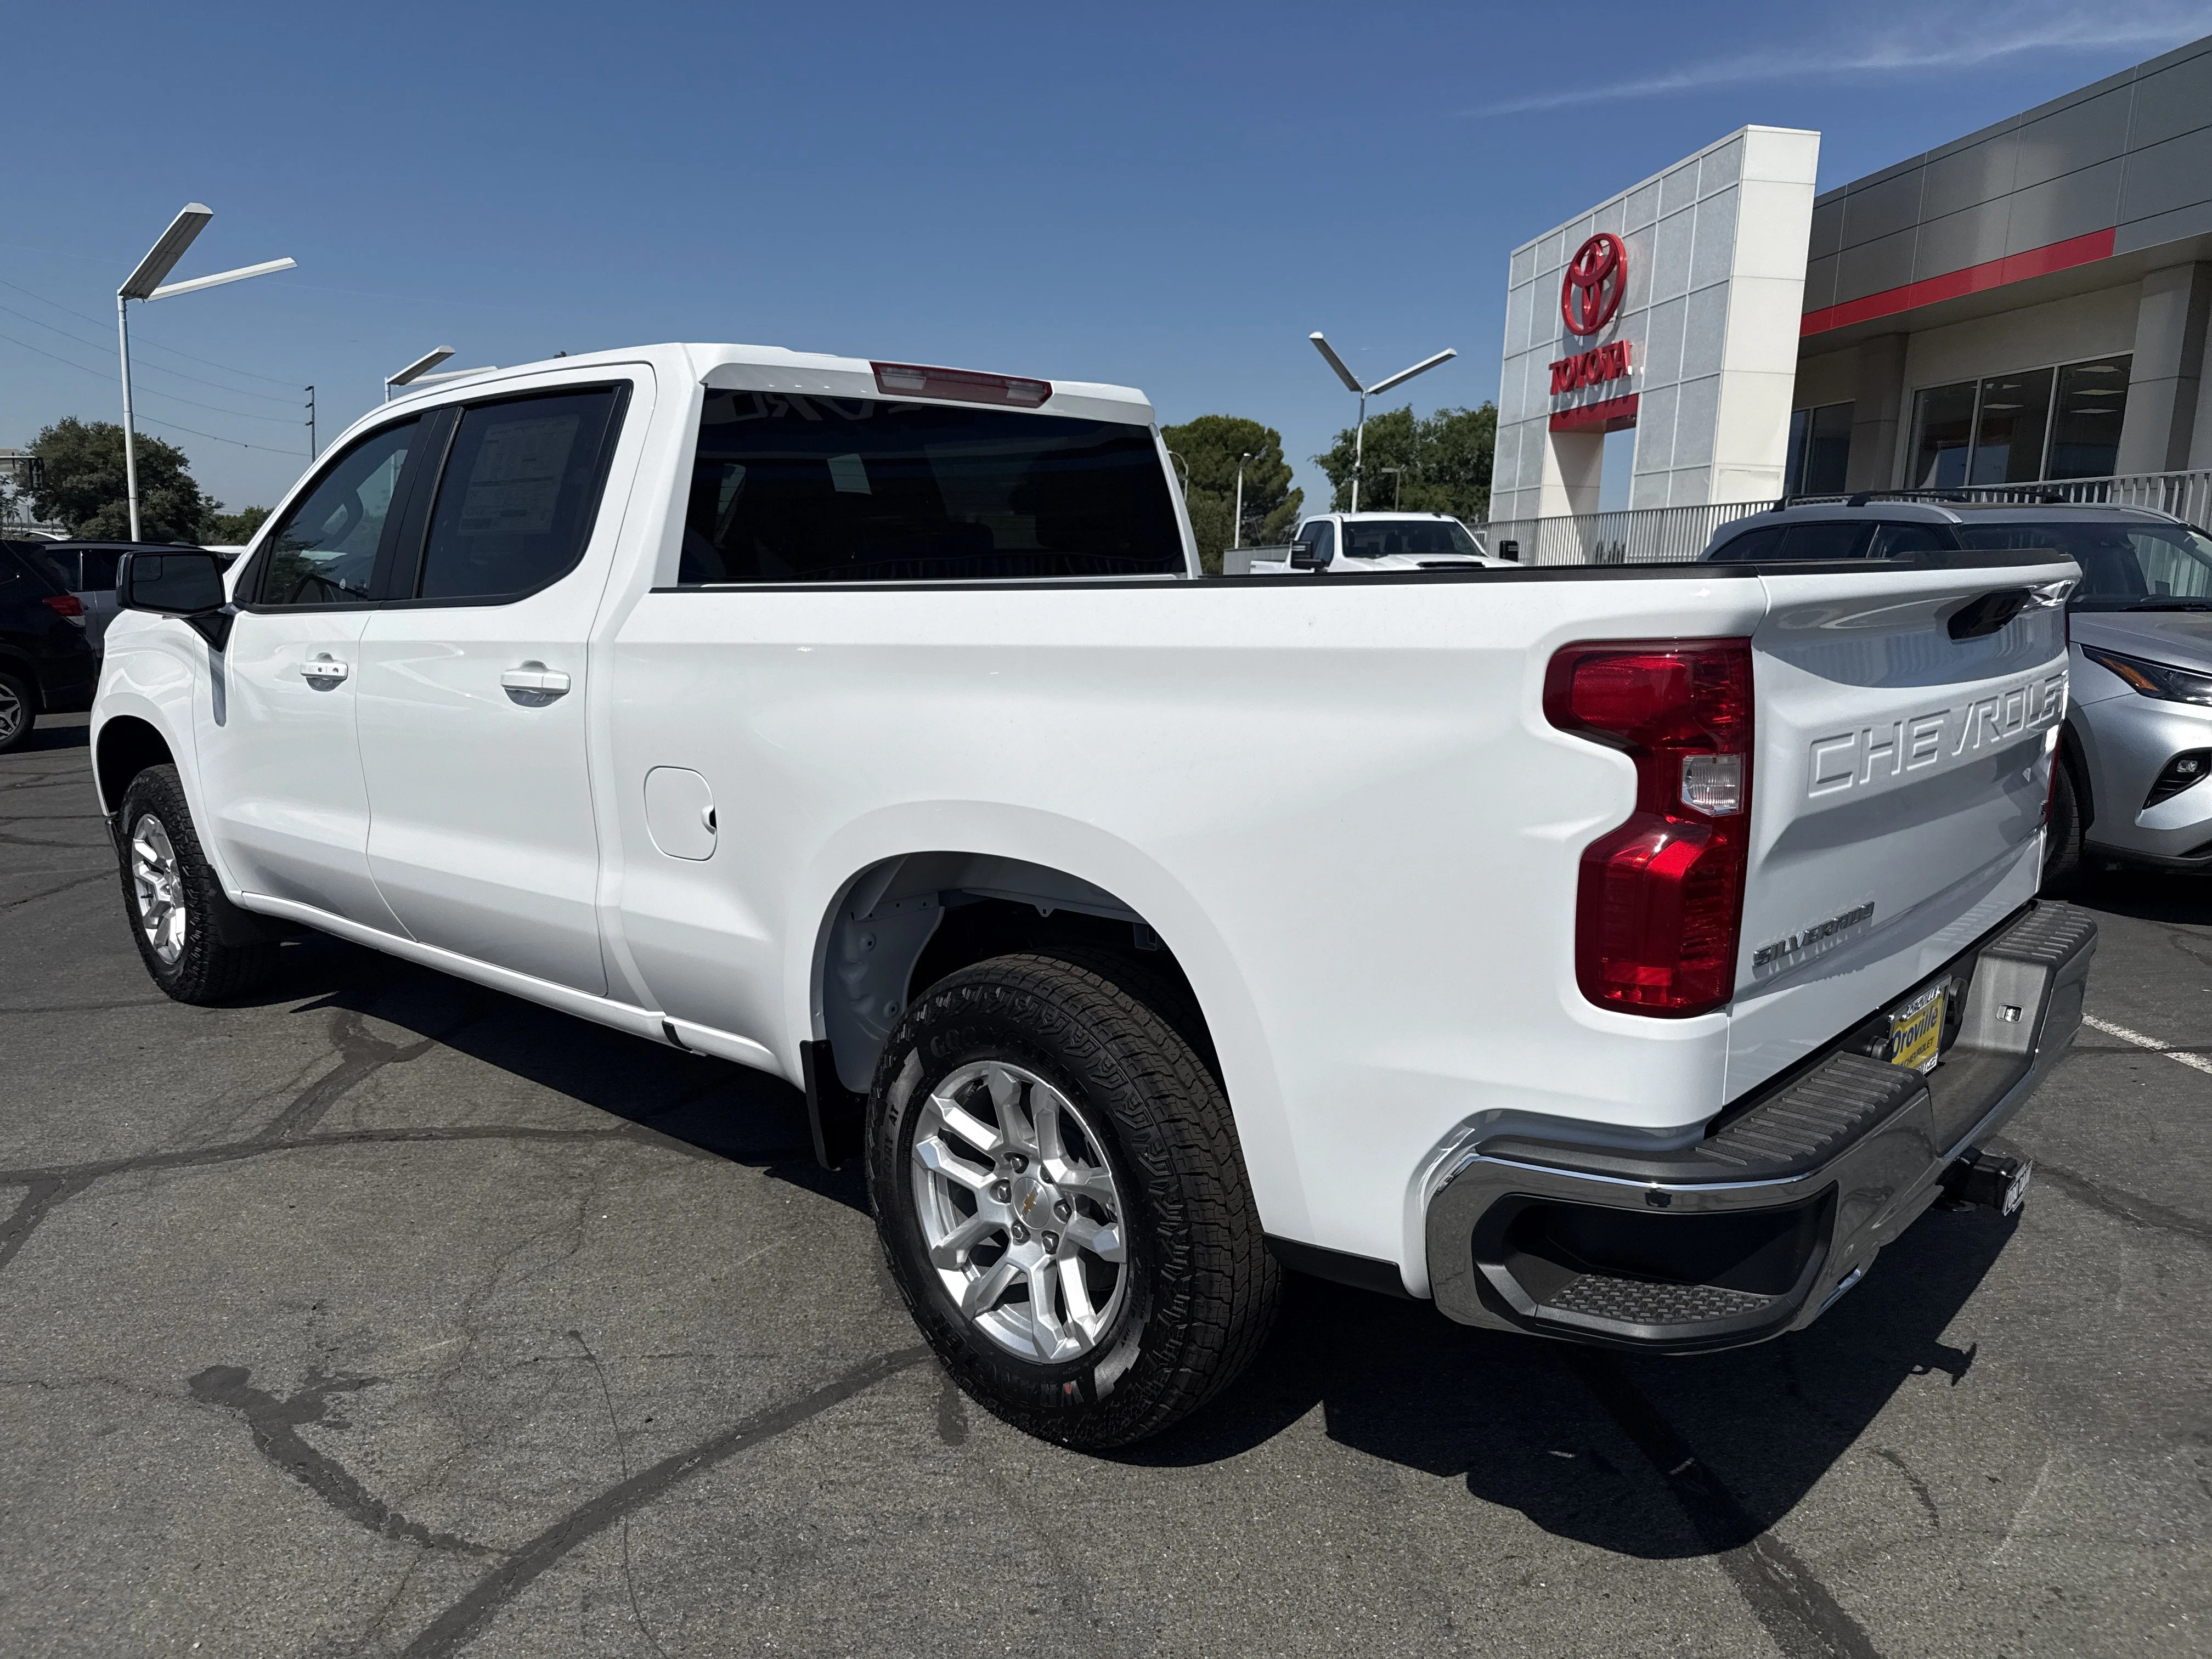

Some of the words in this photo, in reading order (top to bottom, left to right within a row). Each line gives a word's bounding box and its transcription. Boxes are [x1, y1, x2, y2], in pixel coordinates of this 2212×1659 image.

[1549, 339, 1633, 395] TOYOTA
[1752, 900, 1875, 968] SILVERADO
[1892, 1006, 1938, 1058] Oroville
[888, 1104, 900, 1126] AT
